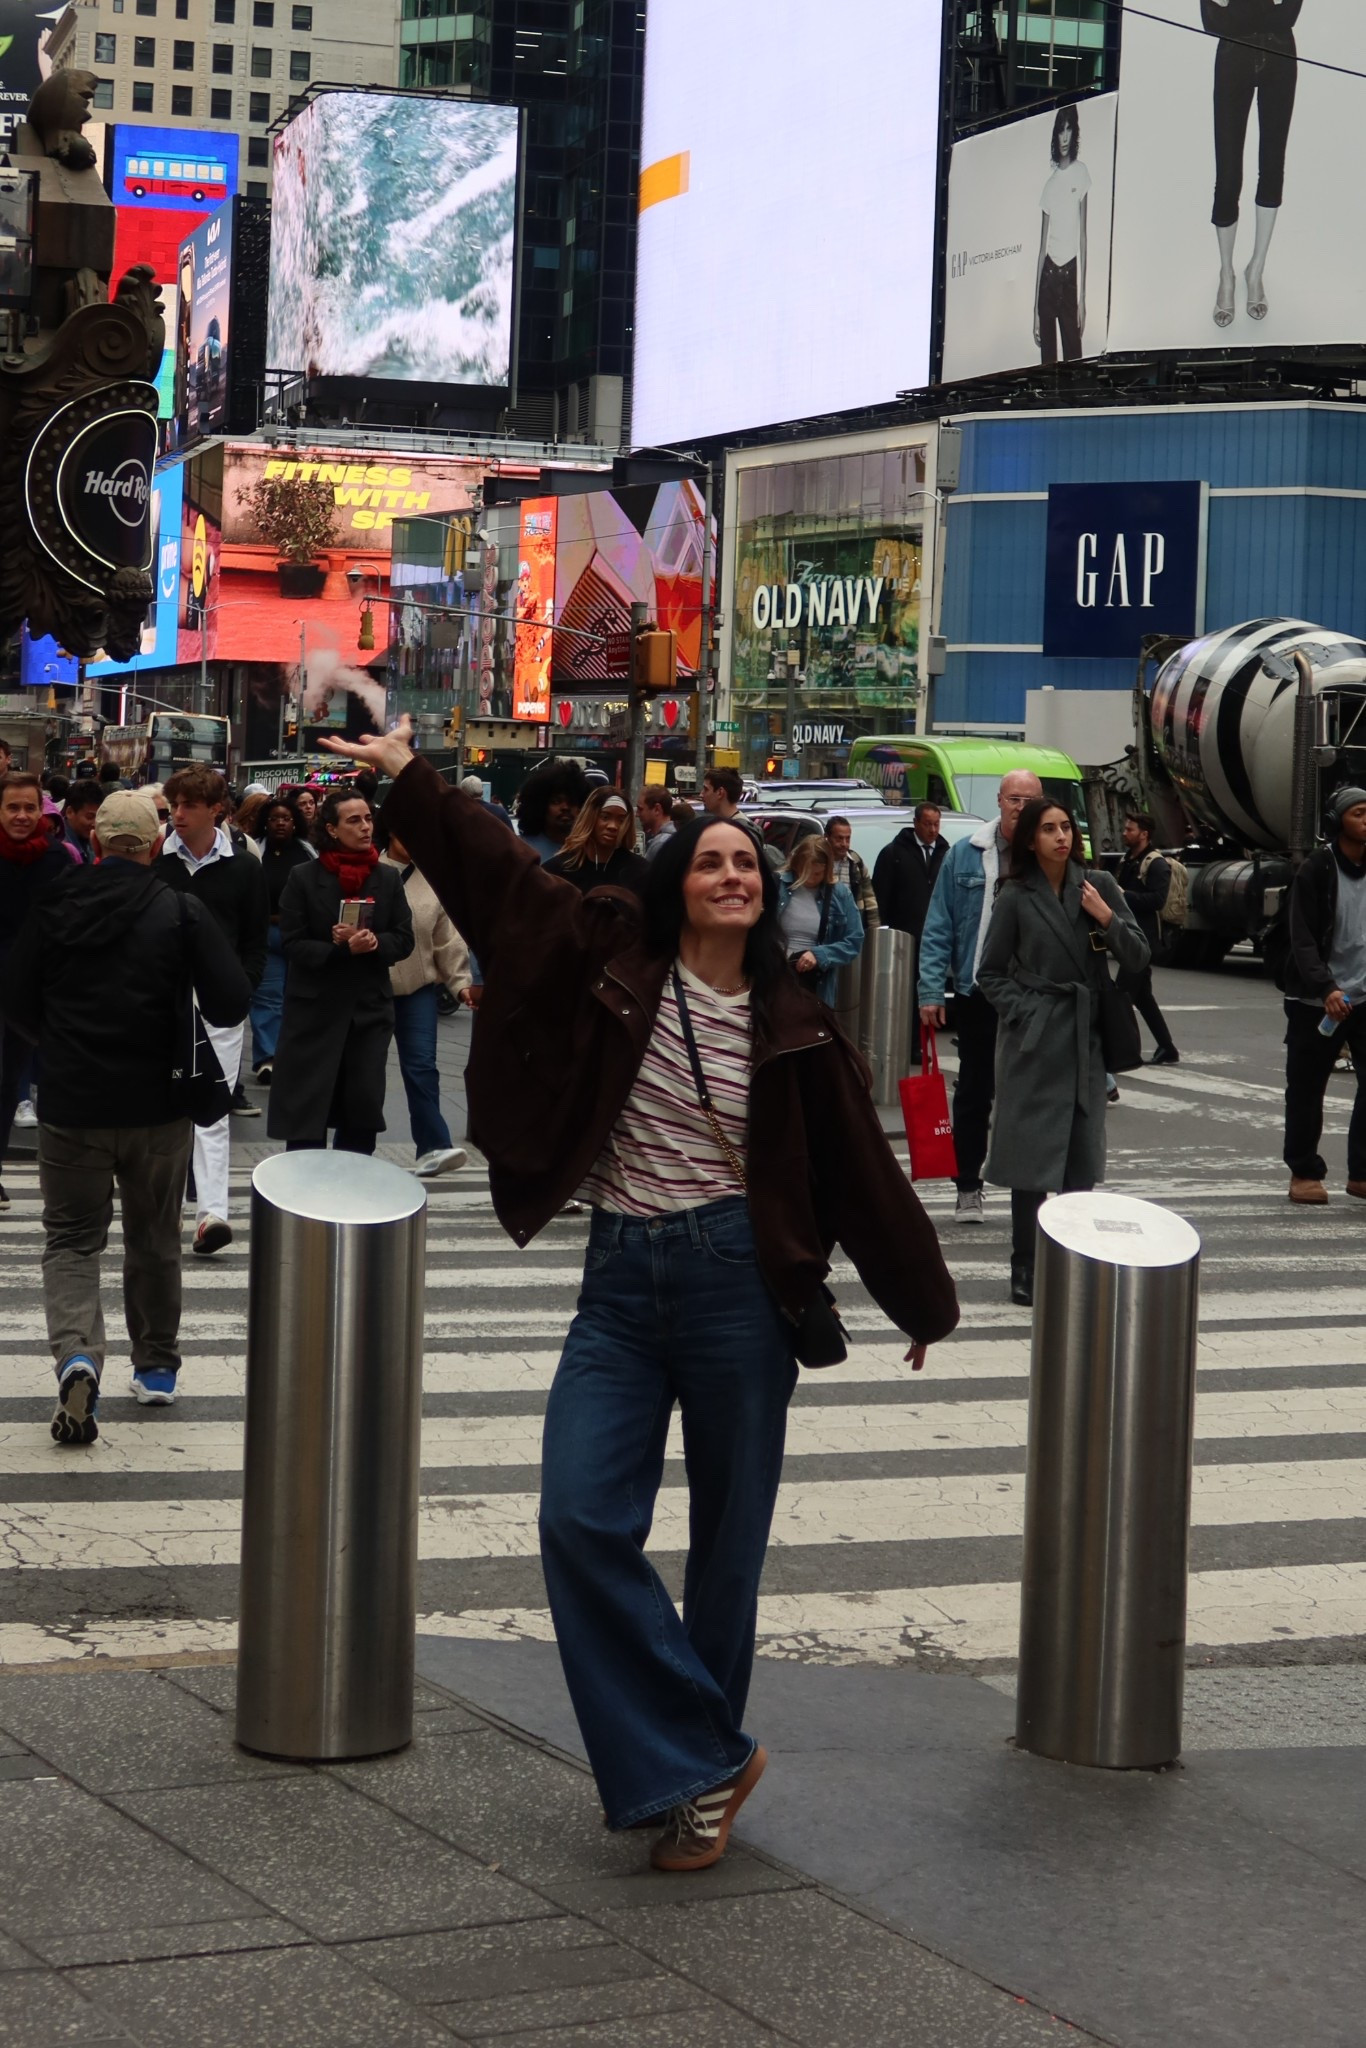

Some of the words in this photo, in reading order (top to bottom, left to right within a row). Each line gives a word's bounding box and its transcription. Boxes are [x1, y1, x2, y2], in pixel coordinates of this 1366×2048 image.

[952, 251, 968, 278] GAP
[969, 252, 994, 265] VICTORIA
[995, 244, 1022, 259] BECKHAM
[84, 470, 134, 498] Hard
[264, 461, 412, 487] FITNESS
[333, 487, 431, 510] WITH
[1076, 532, 1165, 608] GAP
[753, 584, 802, 629] OLD
[808, 577, 884, 627] NAVY
[715, 722, 722, 731] W
[723, 722, 733, 731] 44
[792, 725, 812, 744] OLD
[813, 725, 845, 744] NAVY
[254, 768, 299, 778] DISCOVER
[853, 760, 905, 788] CLEANING
